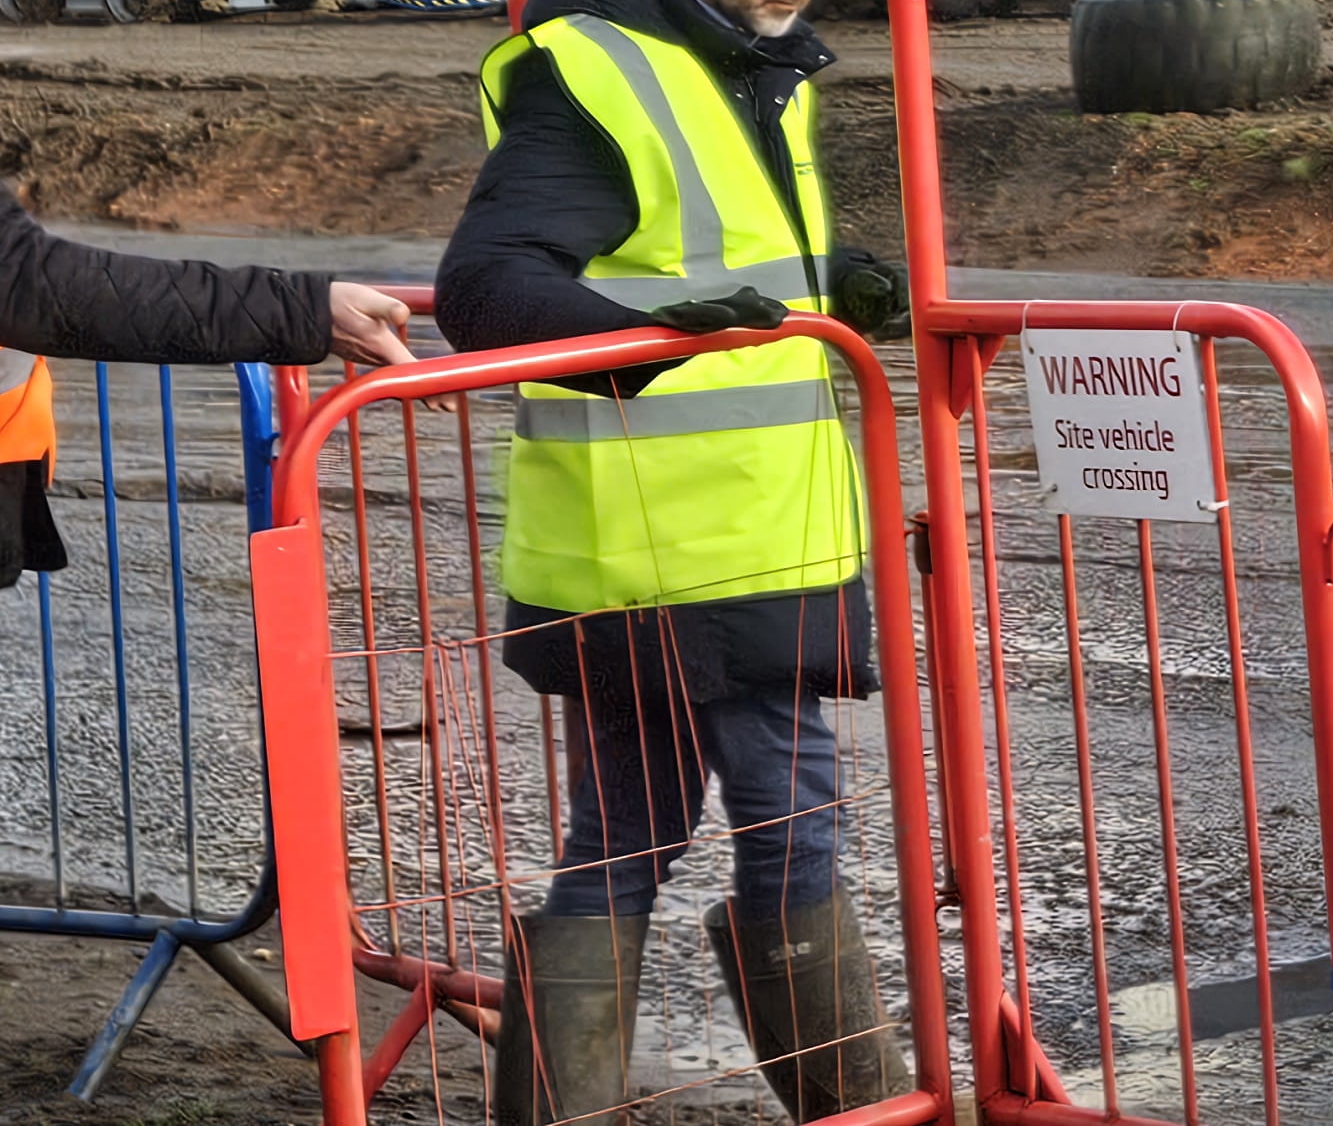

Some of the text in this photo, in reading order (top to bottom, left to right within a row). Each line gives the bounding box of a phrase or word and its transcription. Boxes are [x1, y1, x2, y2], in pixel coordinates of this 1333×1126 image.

[1038, 355, 1182, 397] WARNING
[1055, 419, 1176, 452] Site vehicle
[1082, 461, 1169, 500] crossing
